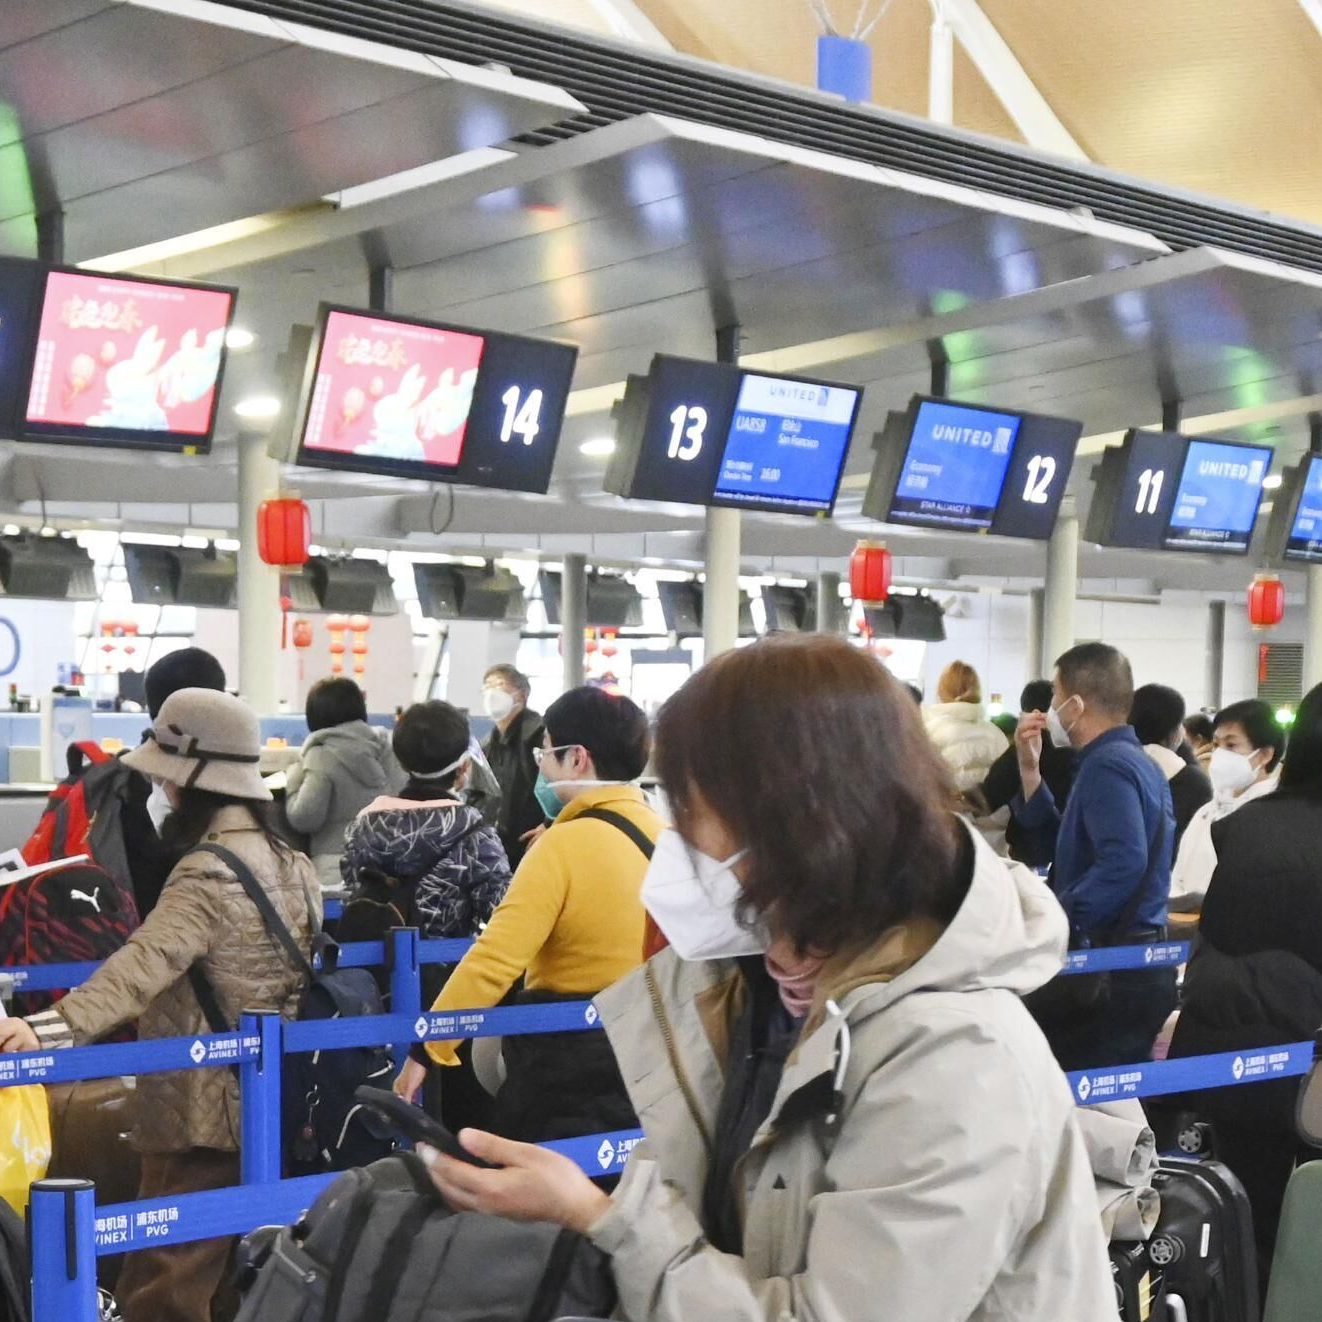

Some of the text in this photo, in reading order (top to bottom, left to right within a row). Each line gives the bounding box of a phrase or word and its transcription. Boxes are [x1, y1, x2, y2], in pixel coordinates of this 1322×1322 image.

[769, 386, 815, 402] UNITED
[501, 384, 543, 446] 14
[667, 404, 708, 461] 13
[933, 424, 993, 447] UNITED
[1022, 455, 1056, 503] 12
[1199, 460, 1248, 479] UNITED
[1135, 469, 1164, 514] 11
[243, 1036, 260, 1047] 浦东
[209, 1047, 260, 1059] AVINEX PV
[29, 1068, 46, 1077] PVG
[95, 1207, 178, 1233] 海机场 浦东机场
[96, 1224, 169, 1245] INEX PVG
